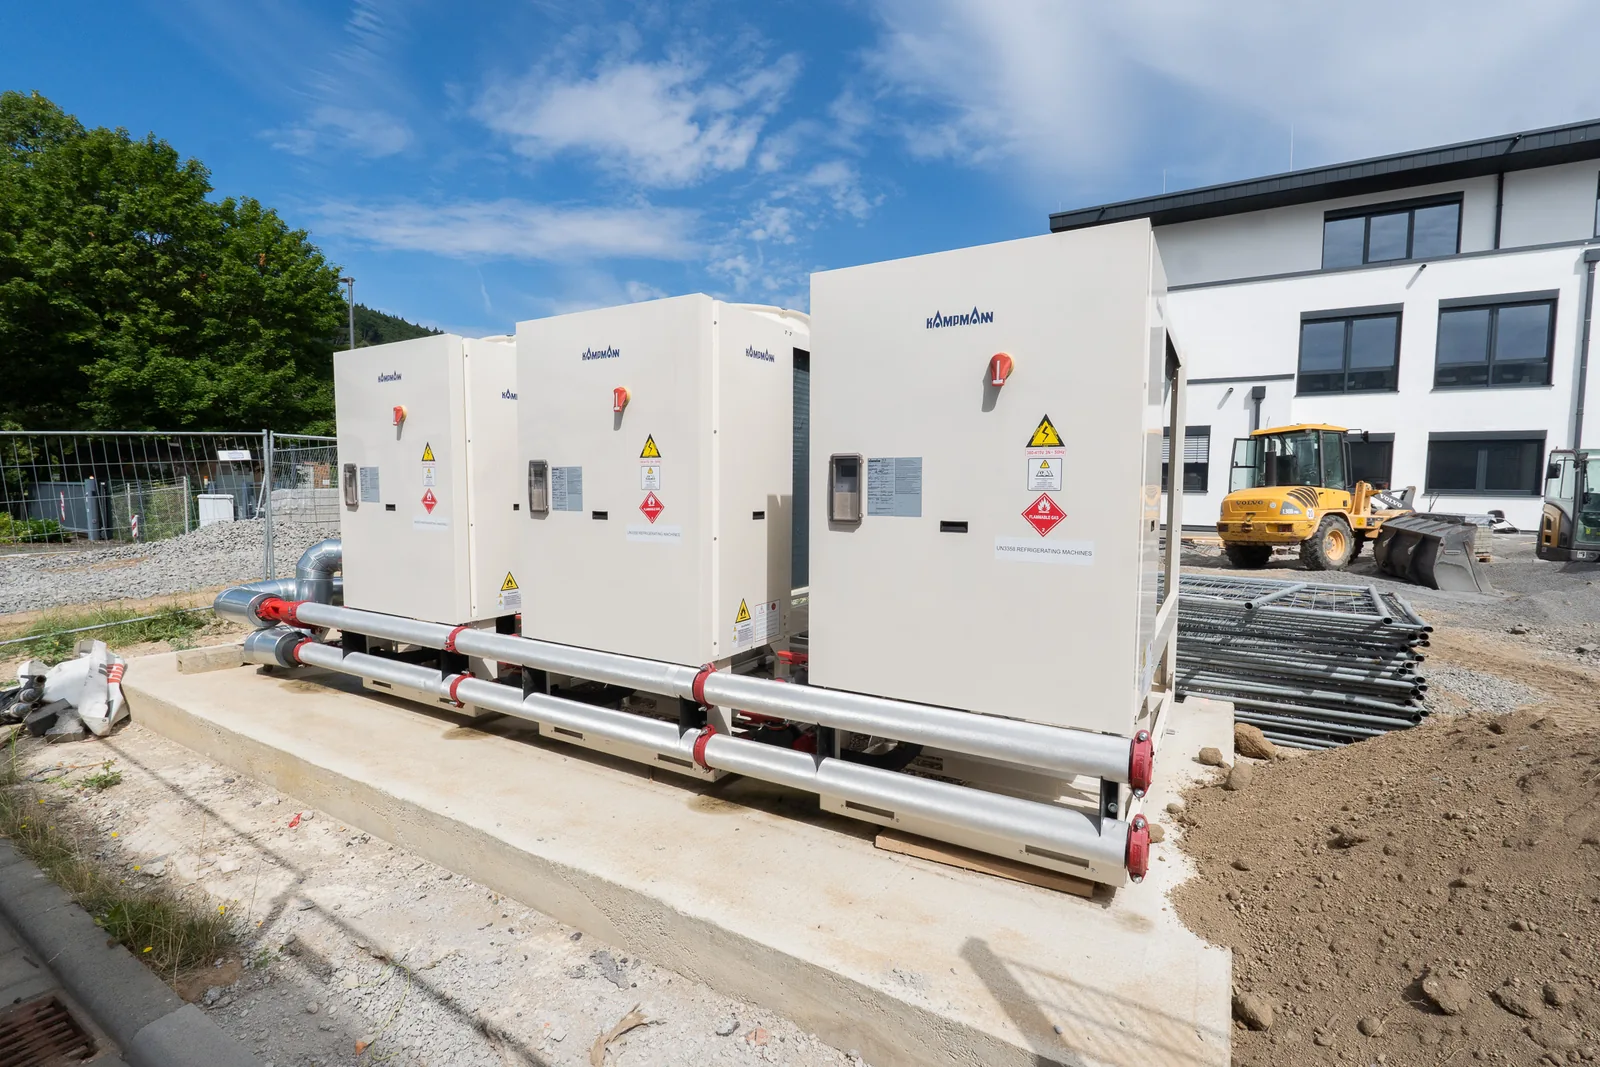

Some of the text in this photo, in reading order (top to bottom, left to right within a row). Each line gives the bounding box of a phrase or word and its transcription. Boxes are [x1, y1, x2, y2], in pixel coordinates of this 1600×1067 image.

[926, 306, 993, 329] KAMPMANN
[582, 345, 619, 360] KAMPMANN
[1380, 494, 1402, 508] VOLVO
[1016, 546, 1061, 555] REFRIGERATING
[1062, 549, 1093, 557] MACHINES
